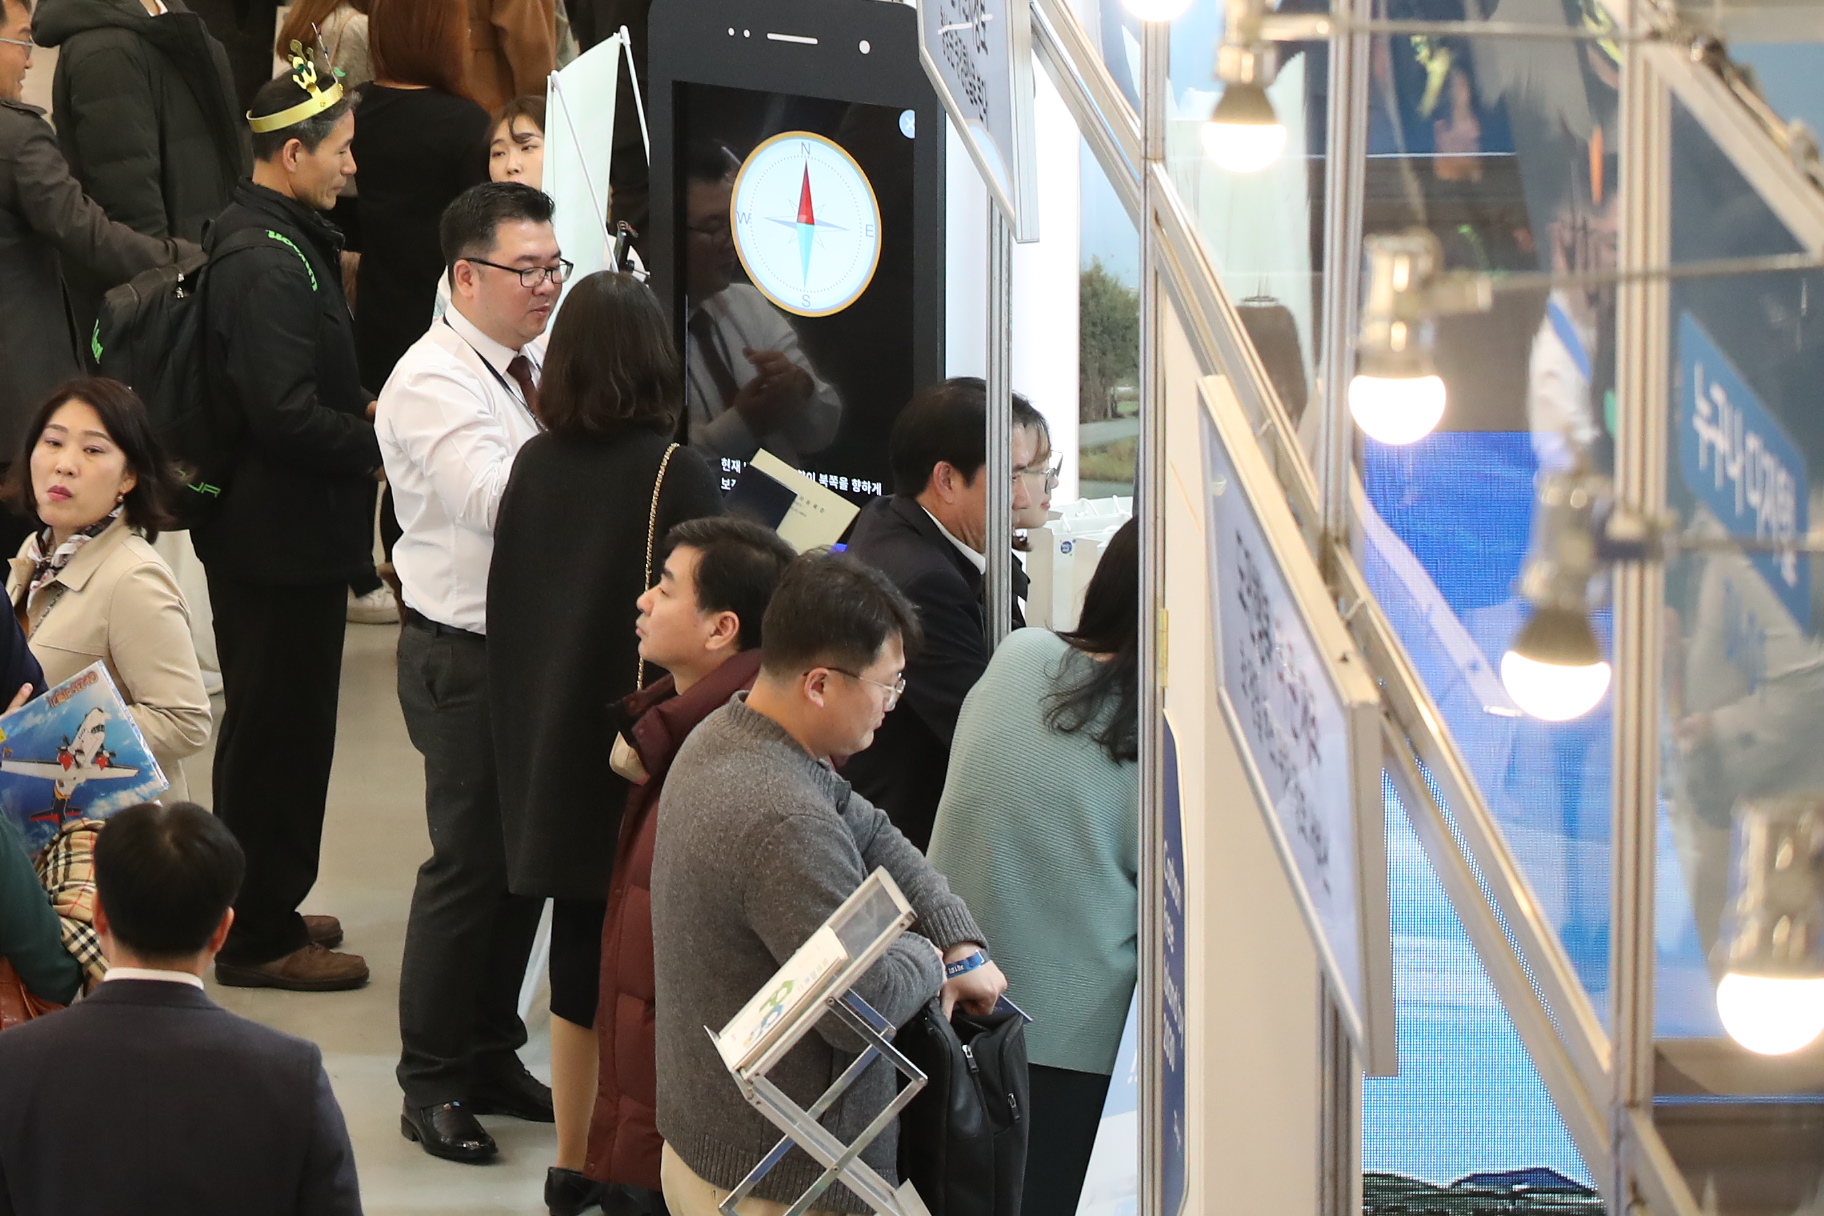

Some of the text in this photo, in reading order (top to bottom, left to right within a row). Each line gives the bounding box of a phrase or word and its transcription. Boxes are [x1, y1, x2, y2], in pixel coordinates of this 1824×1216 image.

[801, 142, 811, 155] N
[736, 211, 874, 238] W E
[802, 294, 811, 307] S
[1693, 361, 1745, 518] 누구나
[720, 457, 741, 474] 현재
[819, 473, 849, 492] 북쪽을
[851, 478, 883, 496] 향하게
